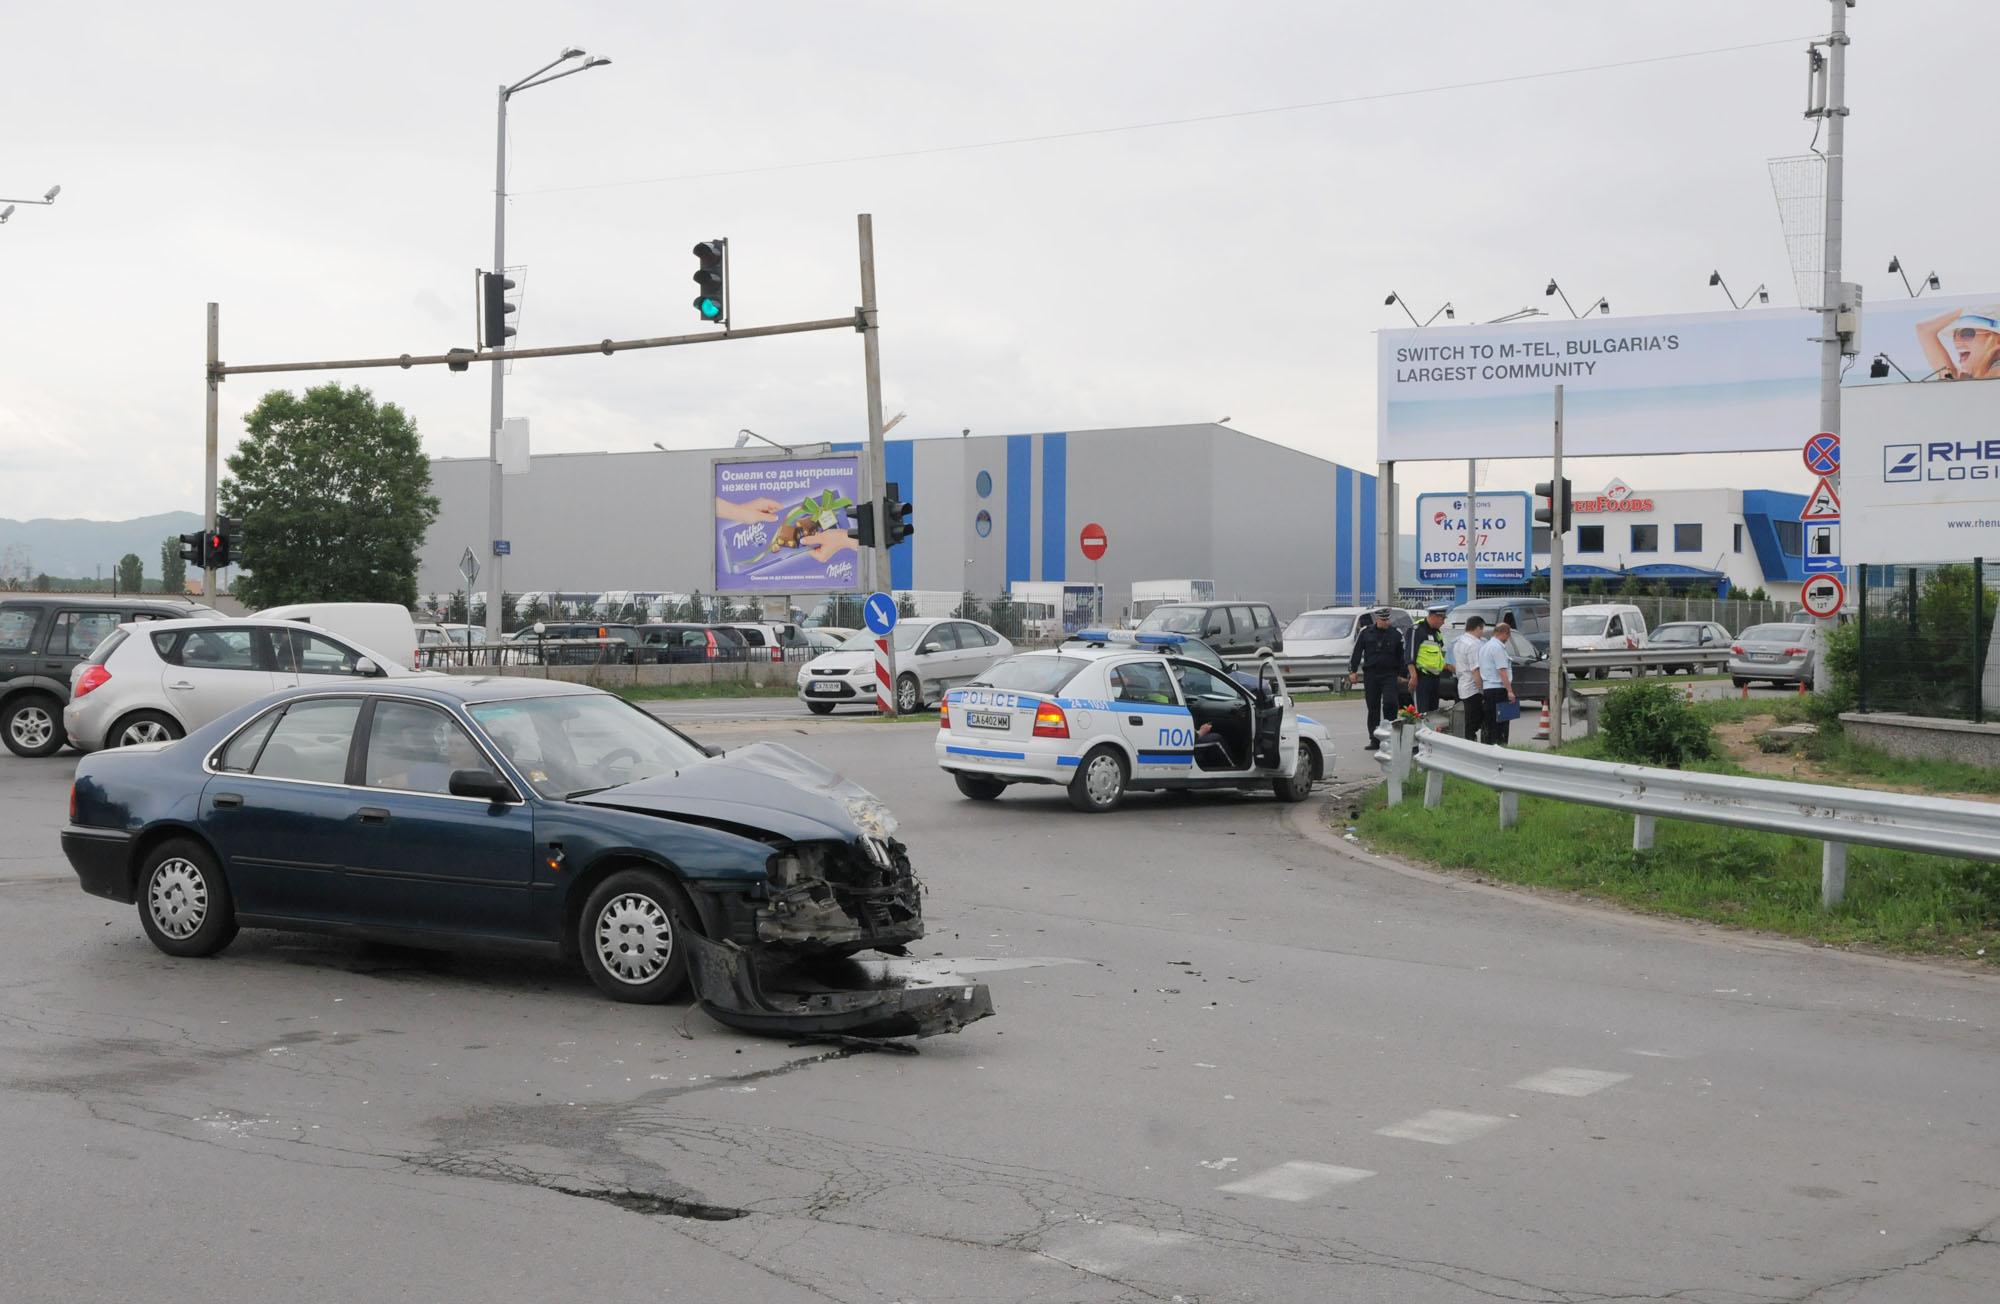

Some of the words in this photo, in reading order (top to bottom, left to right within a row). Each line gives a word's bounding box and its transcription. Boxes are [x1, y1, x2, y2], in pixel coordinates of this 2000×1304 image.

[1397, 345, 1464, 362] SWITCH
[1471, 344, 1494, 360] TO
[1500, 342, 1560, 359] M-TEL,
[1566, 335, 1680, 355] BULGARIA'S
[1397, 366, 1477, 383] LARGEST
[1482, 361, 1597, 380] COMMUNITY
[721, 470, 763, 481] Осмели
[765, 471, 777, 479] се
[779, 469, 793, 479] да
[796, 467, 853, 478] направиш
[1927, 465, 1999, 481] LOGI
[721, 482, 758, 492] нежен
[759, 478, 810, 491] подарък!
[733, 522, 765, 549] Milka
[1458, 534, 1488, 547] 2/7
[826, 561, 853, 578] Milka
[961, 690, 1015, 708] POLICE
[1158, 728, 1194, 747] ПОЛ
